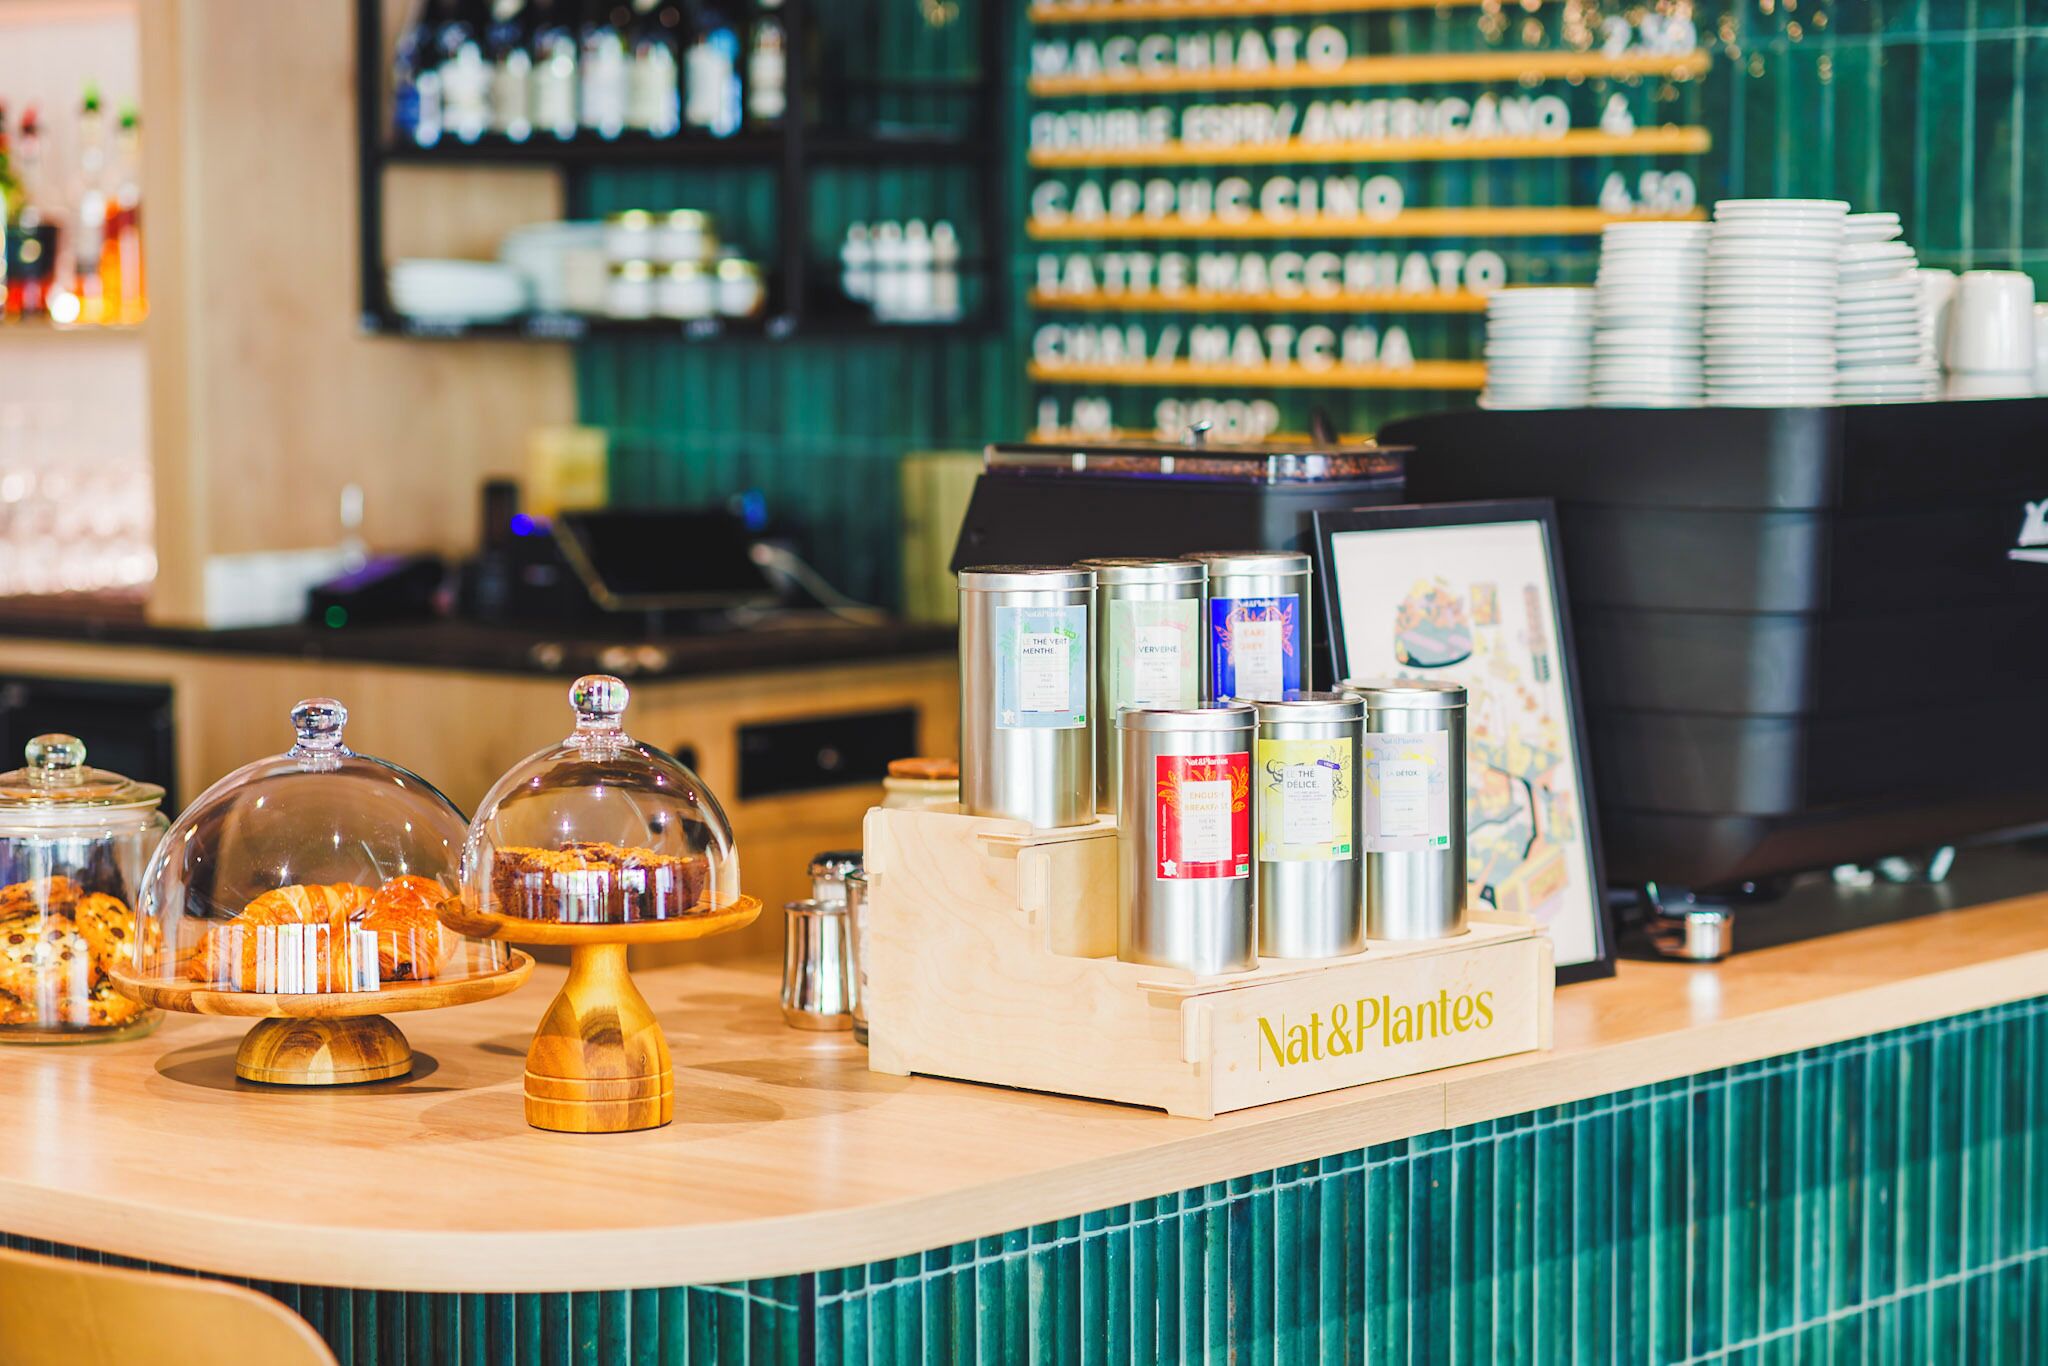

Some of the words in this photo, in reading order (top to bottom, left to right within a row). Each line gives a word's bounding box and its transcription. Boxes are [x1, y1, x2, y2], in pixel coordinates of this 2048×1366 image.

[1031, 25, 1348, 81] MACCHIATO
[1601, 92, 1635, 137] 4
[1031, 174, 1404, 227] CAPPUCCINO
[1599, 170, 1696, 215] 4.50
[1036, 252, 1192, 299] LATTE
[1196, 250, 1506, 298] MACCHIATO
